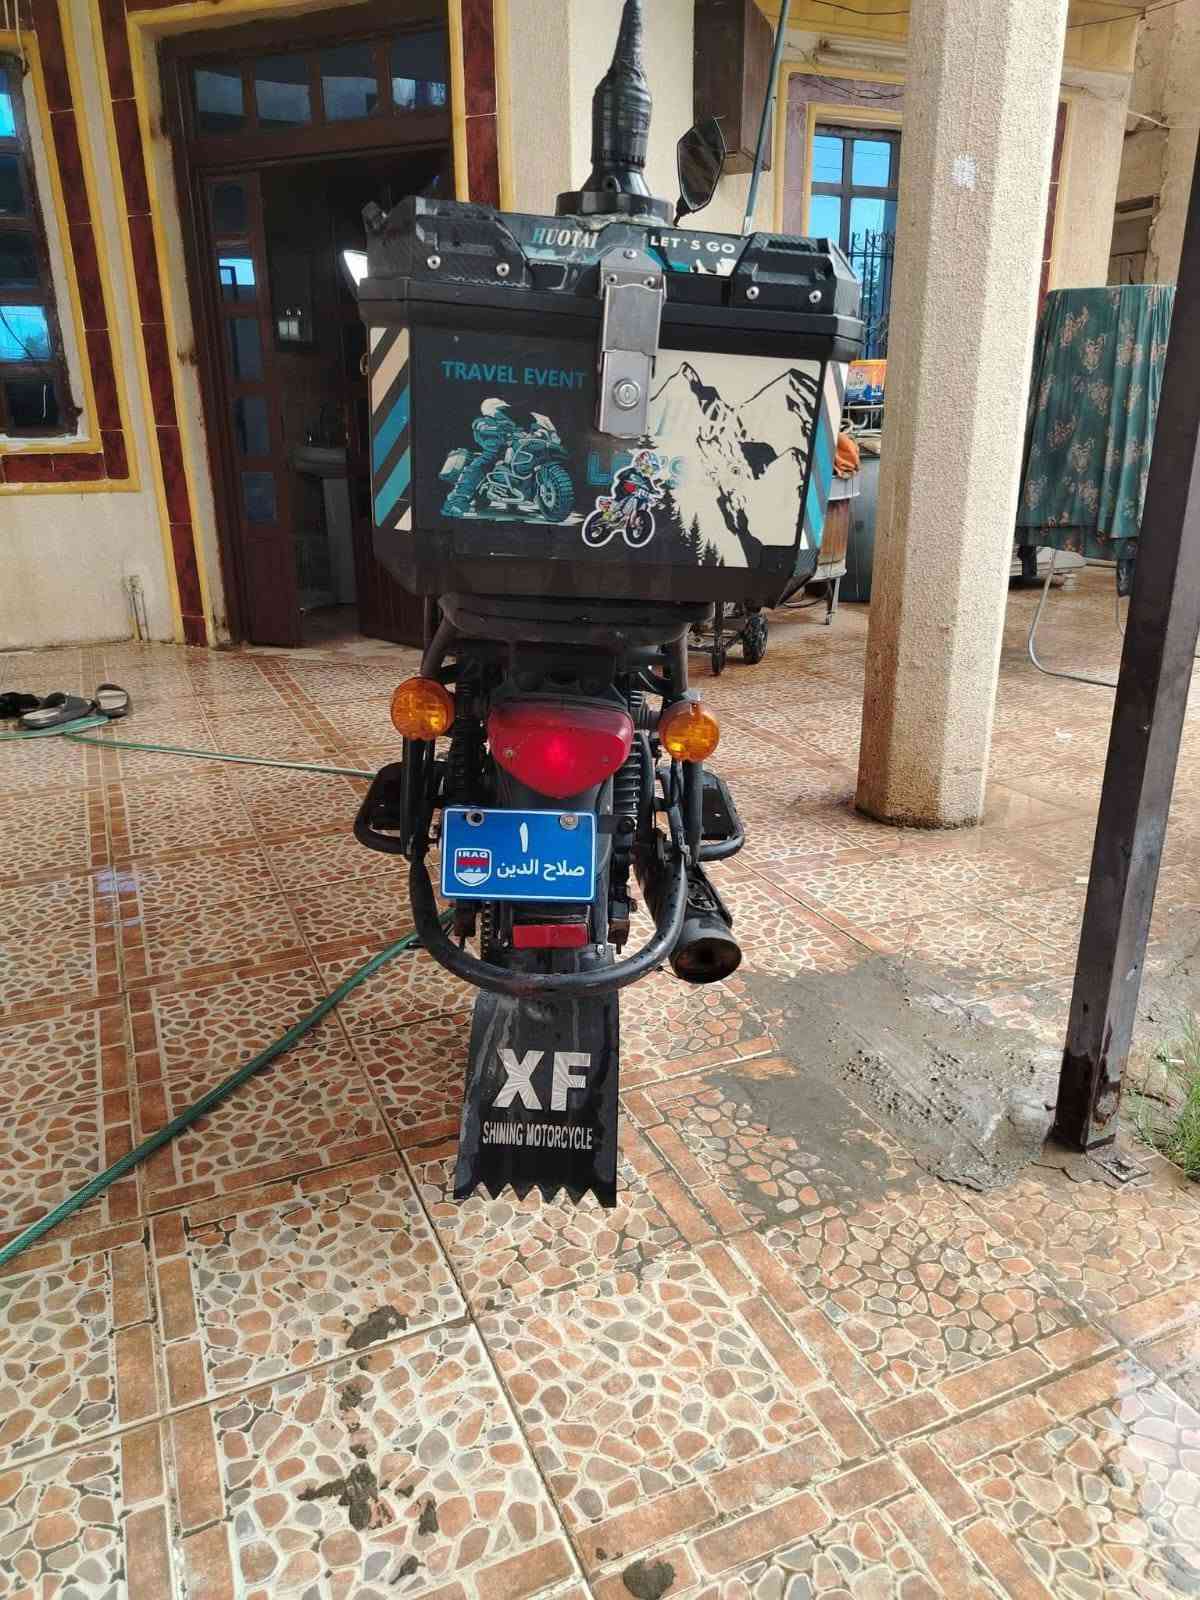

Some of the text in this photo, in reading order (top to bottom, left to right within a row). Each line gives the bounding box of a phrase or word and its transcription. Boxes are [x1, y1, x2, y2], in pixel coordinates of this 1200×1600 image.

[531, 228, 600, 249] HUOTAI
[706, 241, 735, 253] GO
[441, 360, 587, 390] TRAVEL EVENT
[496, 858, 585, 881] صلاح الدين
[482, 1121, 592, 1150] SHINING MOTORCYCLE
